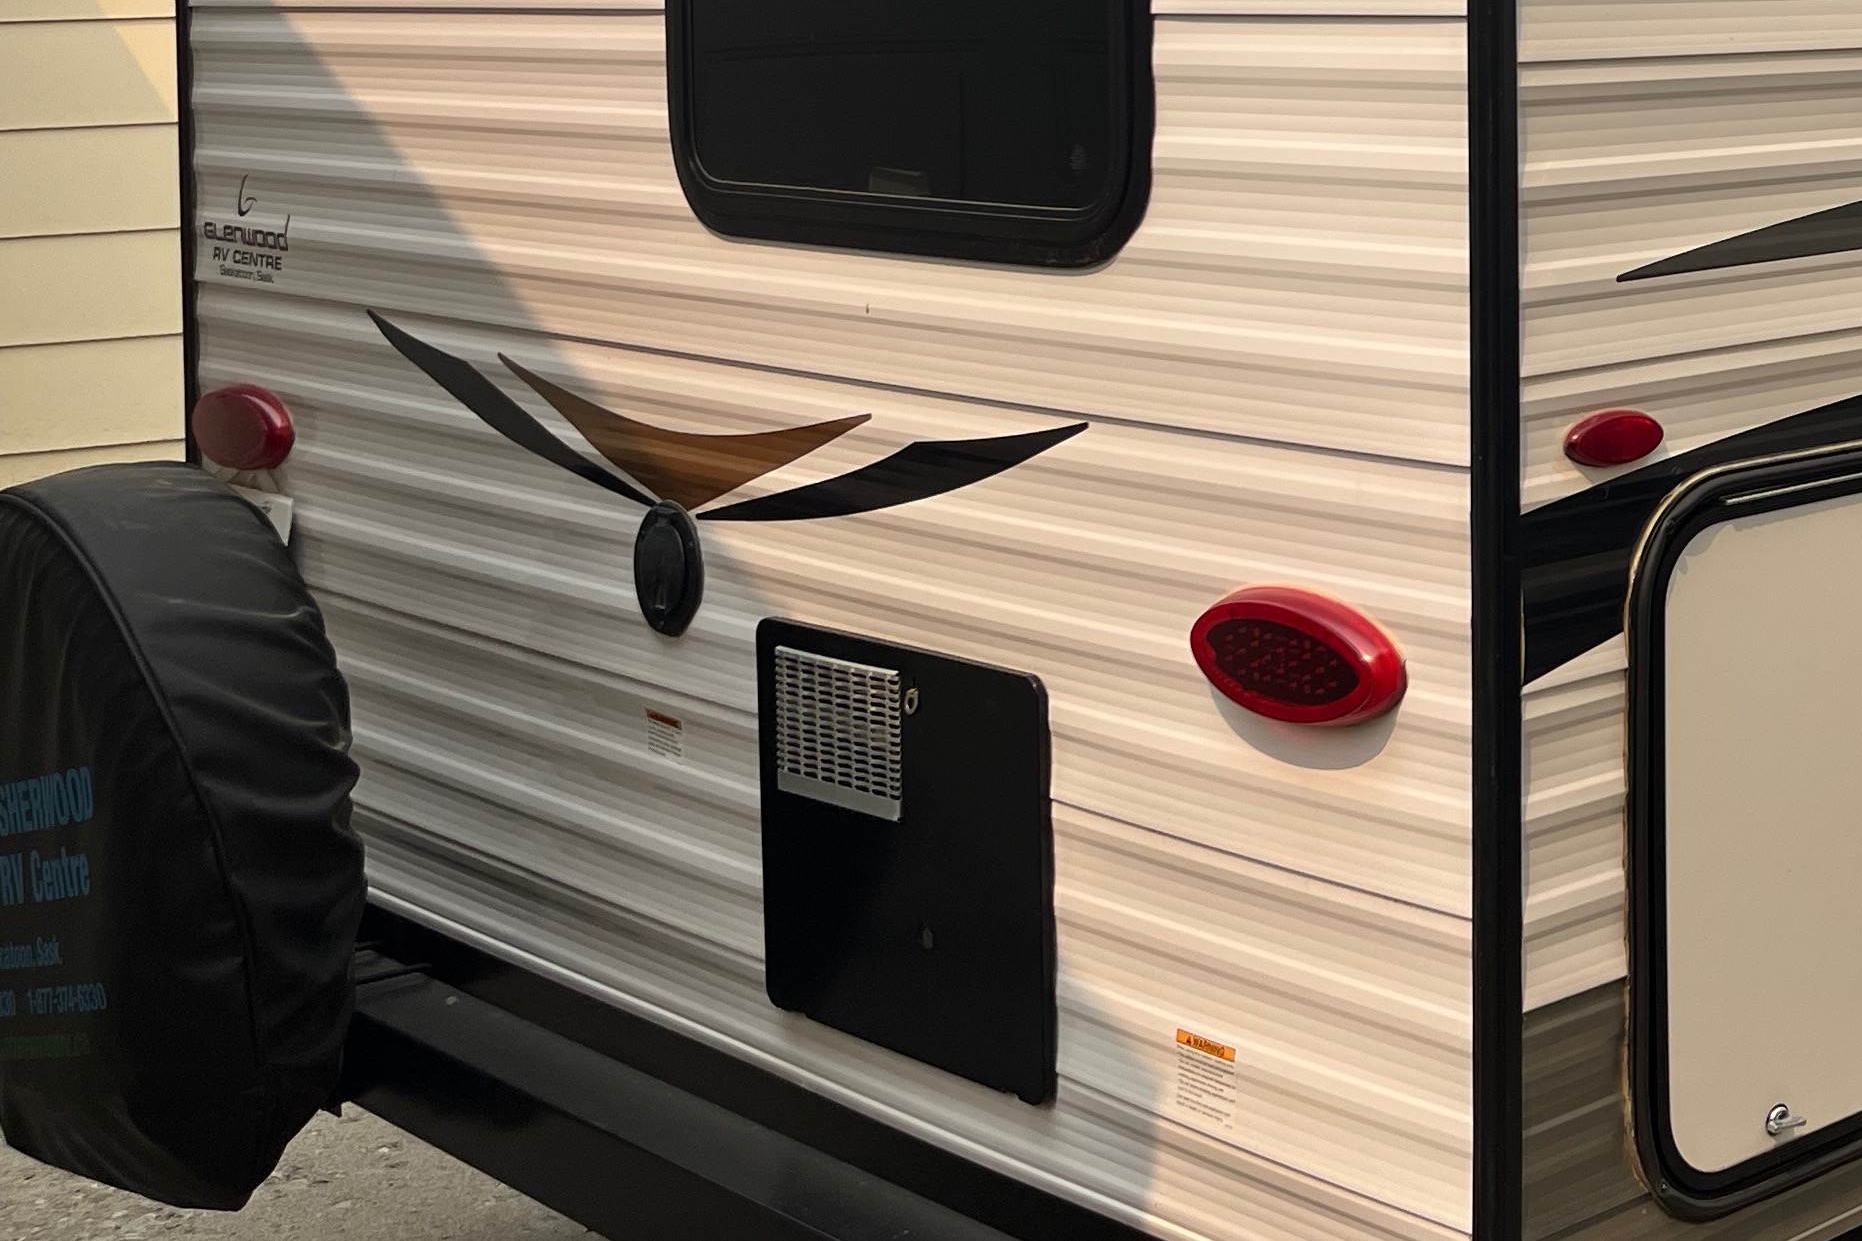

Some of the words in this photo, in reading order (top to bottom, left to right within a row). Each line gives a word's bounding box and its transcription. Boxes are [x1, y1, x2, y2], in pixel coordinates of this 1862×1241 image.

[213, 246, 230, 261] RV
[233, 250, 282, 270] CENTRE
[0, 766, 94, 837] SHERWOOD
[0, 852, 24, 907] RV
[30, 845, 91, 904] Centre
